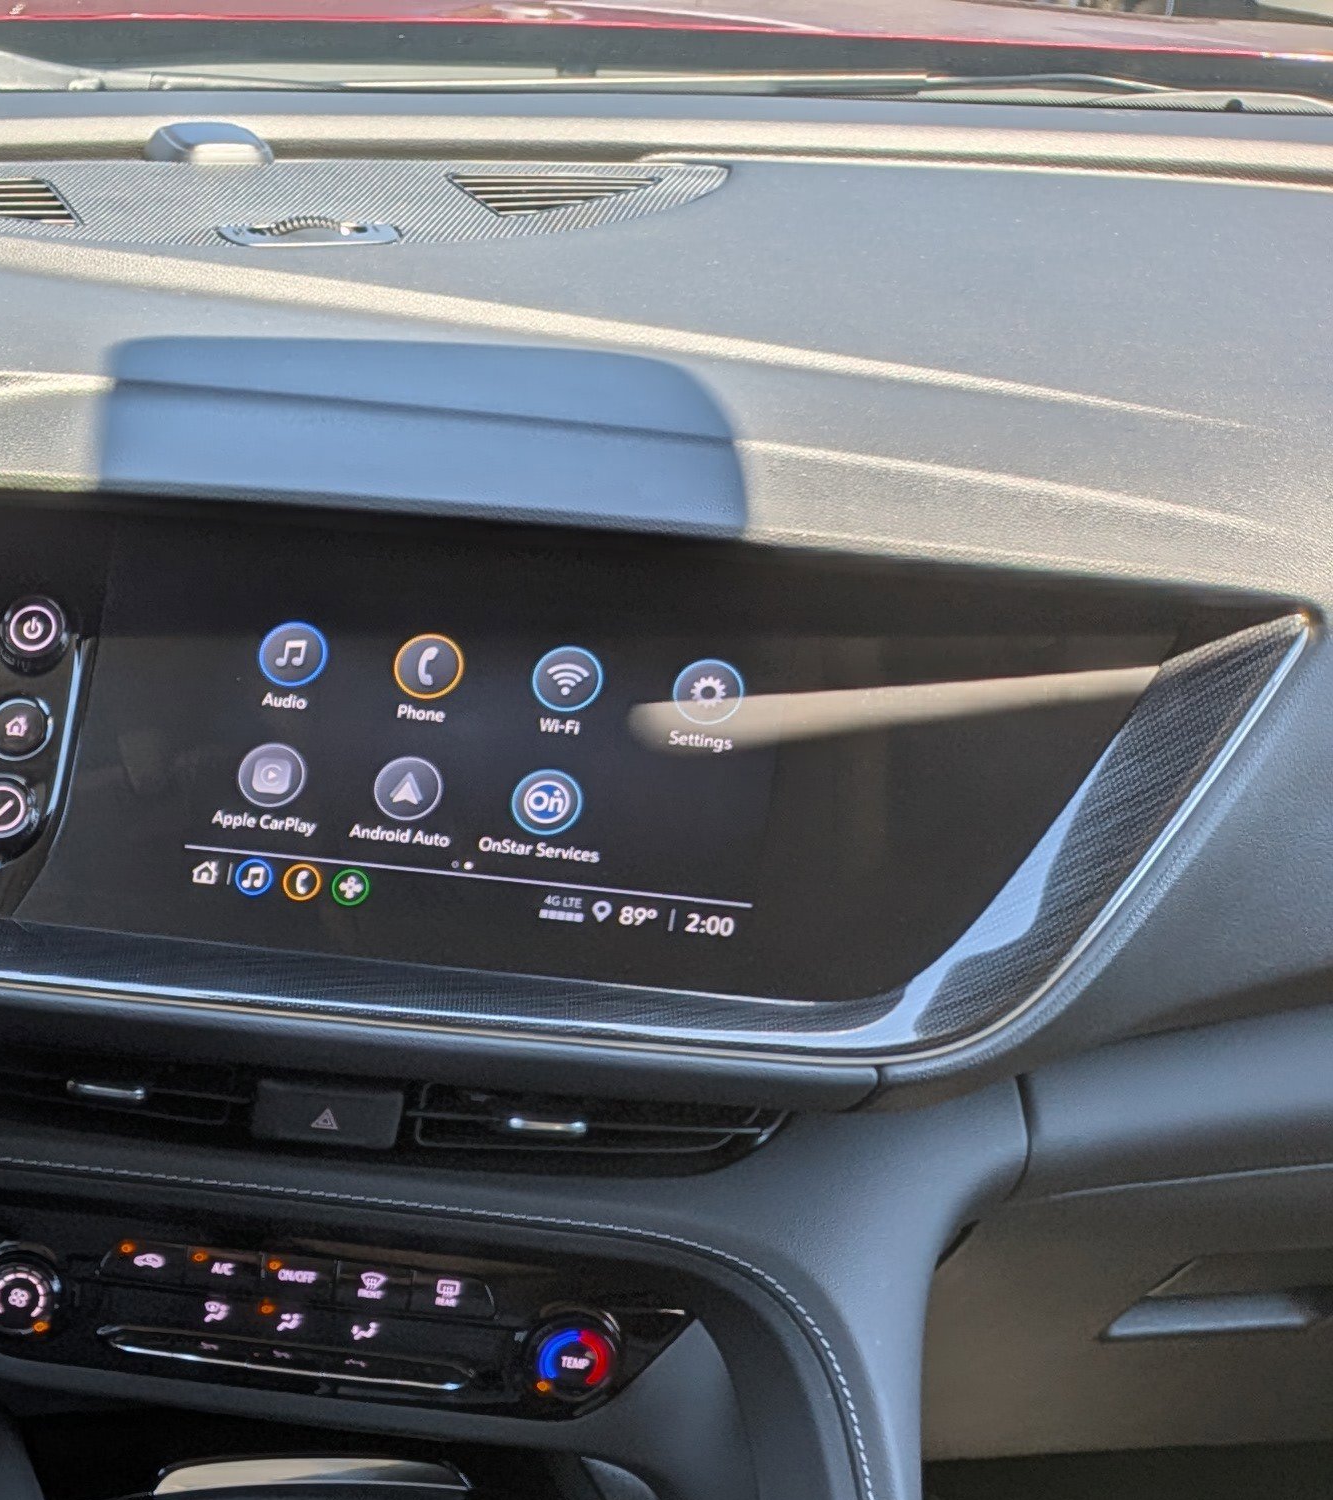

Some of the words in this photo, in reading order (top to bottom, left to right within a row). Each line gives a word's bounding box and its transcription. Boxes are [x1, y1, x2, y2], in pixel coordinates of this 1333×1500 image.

[261, 691, 308, 710] Audio
[397, 704, 446, 722] Phone
[539, 717, 581, 736] Wi-Fi
[668, 730, 733, 753] Settings
[211, 809, 257, 830] Apple
[259, 814, 317, 837] CarPlay
[349, 824, 409, 844] Android
[412, 830, 451, 848] Auto
[478, 836, 533, 856] OnStar
[535, 842, 601, 864] Services
[544, 894, 561, 907] 4G
[562, 896, 583, 909] LTE
[684, 912, 735, 937] 2:00
[561, 1355, 590, 1370] TEMP
